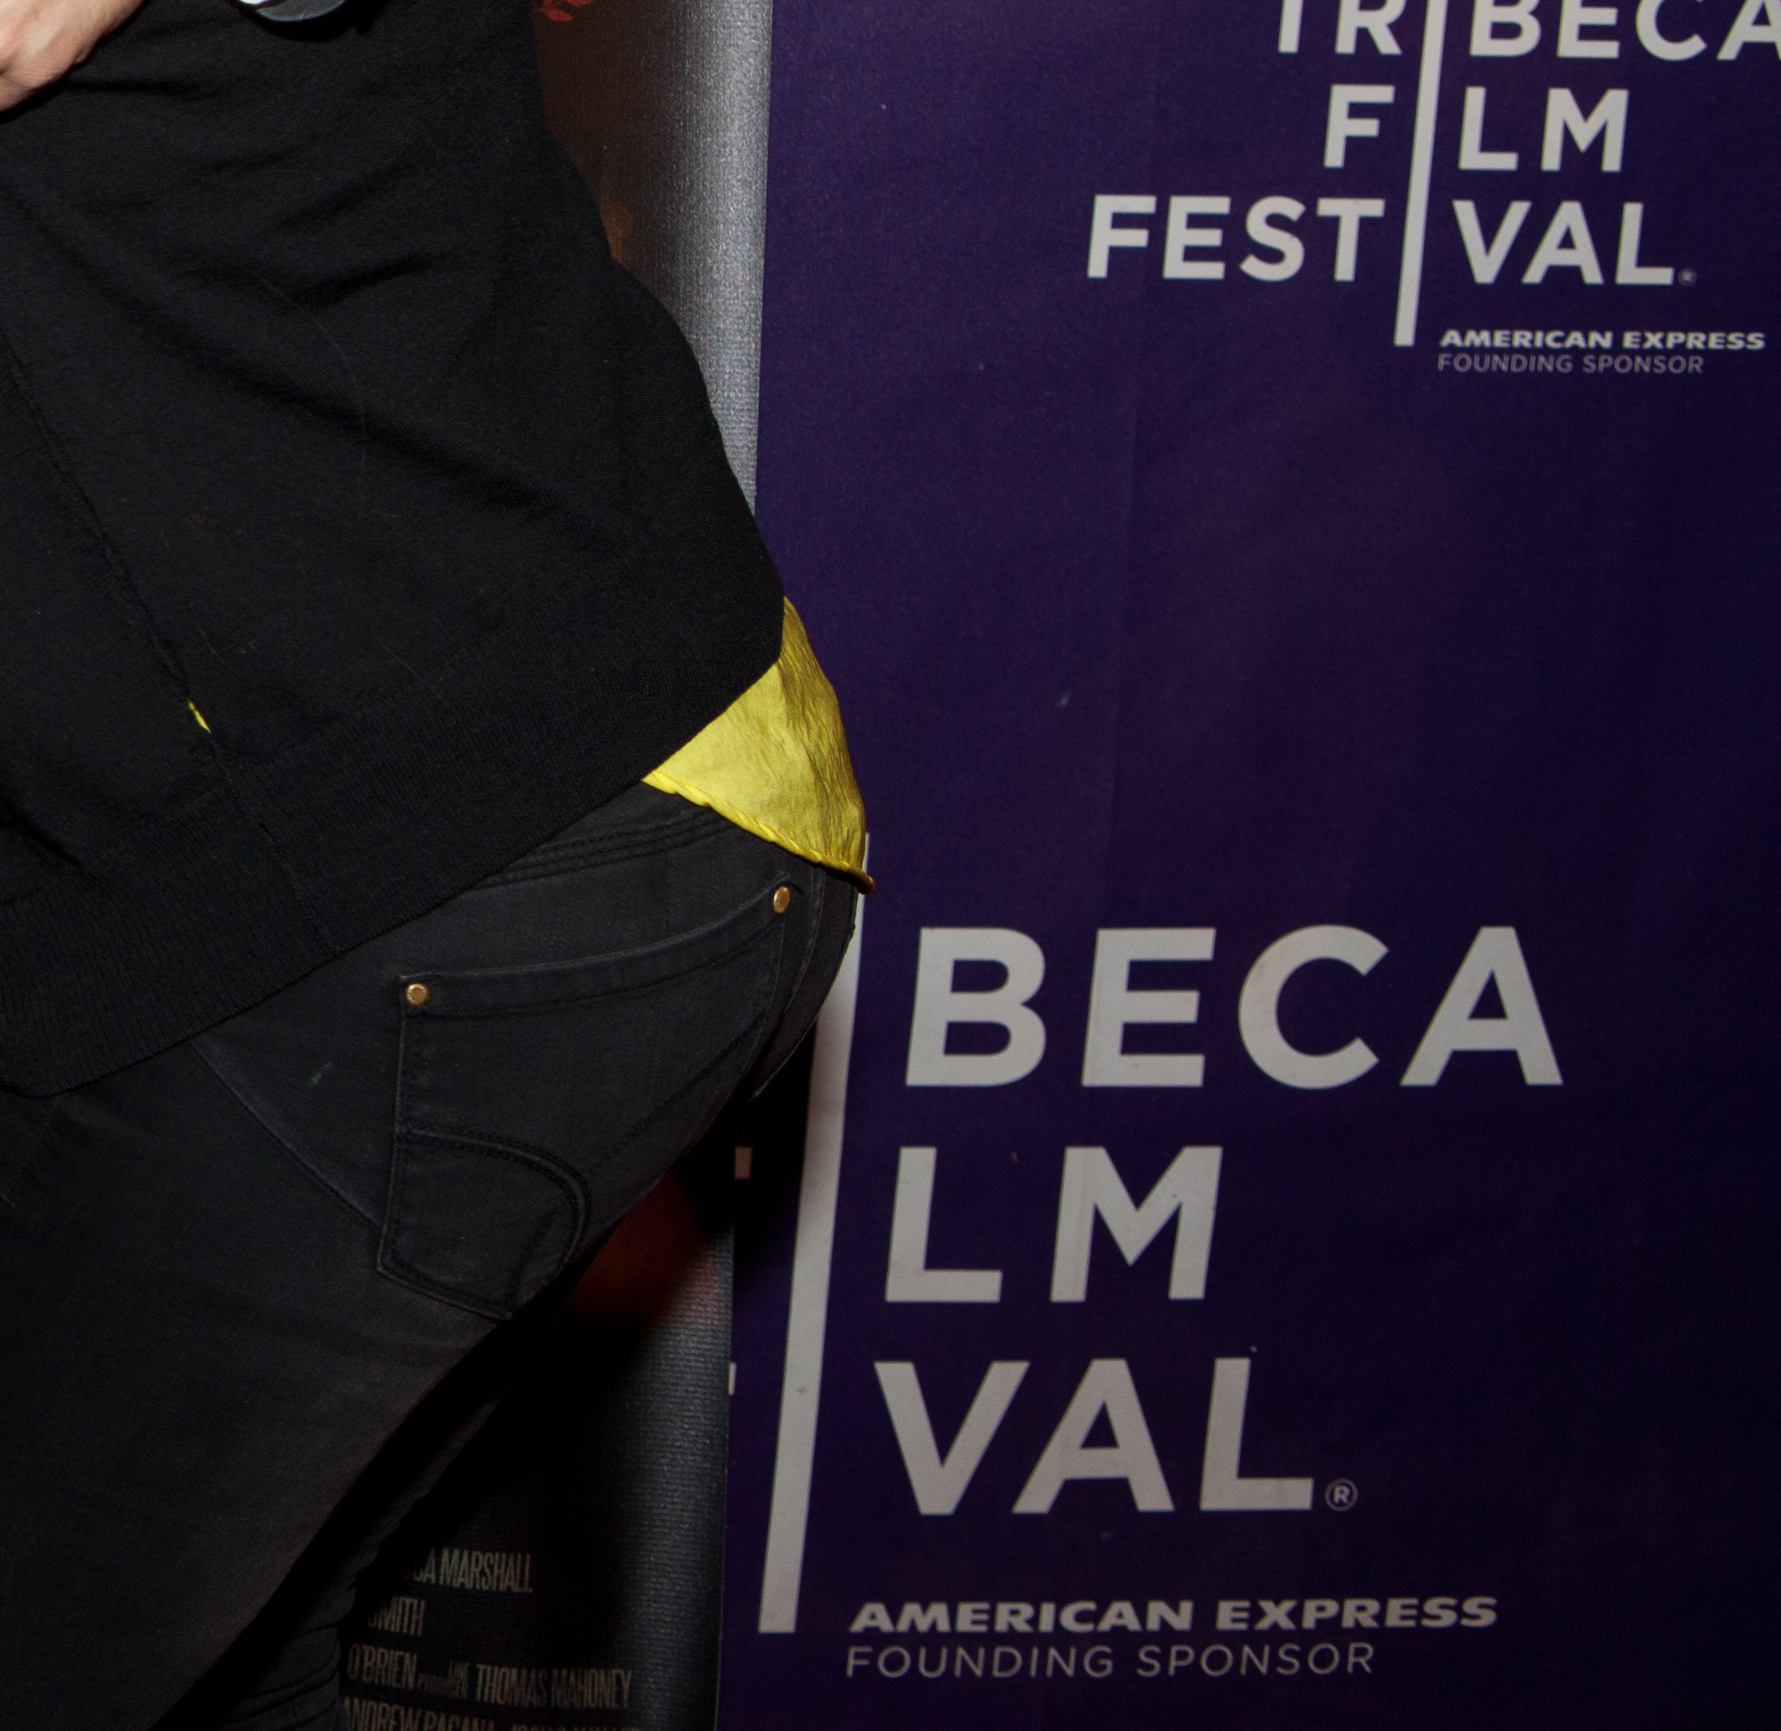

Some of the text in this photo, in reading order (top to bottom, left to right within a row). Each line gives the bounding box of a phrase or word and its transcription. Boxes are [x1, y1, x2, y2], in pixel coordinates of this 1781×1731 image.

[1440, 329, 1765, 351] AMERICAN EXPRESS
[1438, 352, 1704, 374] FOUNDING SPONSOR
[439, 1547, 534, 1594] MARSHALL
[851, 1597, 1495, 1632] AMERICAN EXPRESS
[348, 1644, 418, 1690] O'BRIEN
[476, 1663, 548, 1708] THOMAS
[551, 1666, 634, 1710] MAHONEY
[847, 1643, 1373, 1677] FOUNDING SPONSOR
